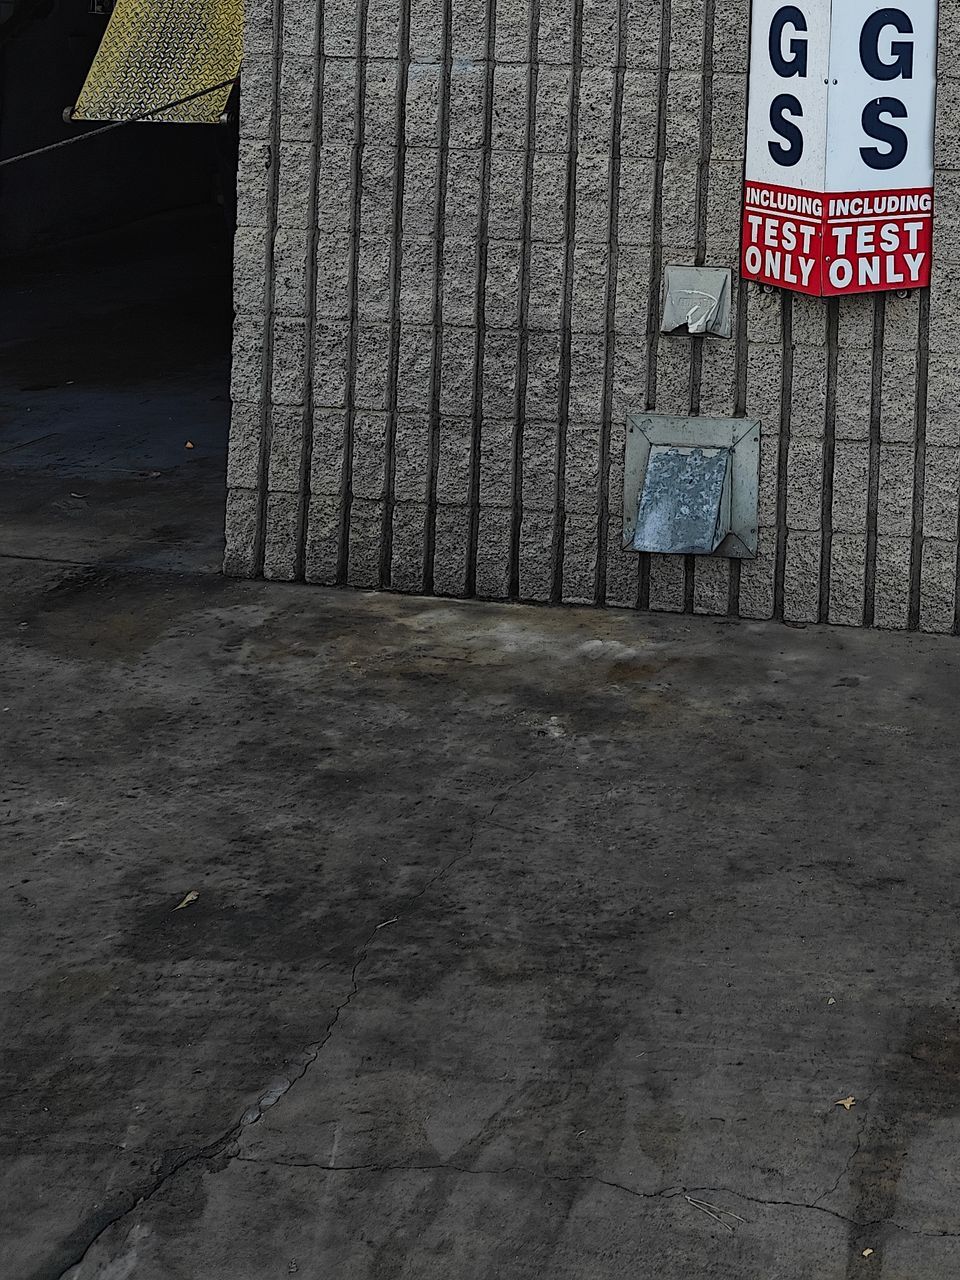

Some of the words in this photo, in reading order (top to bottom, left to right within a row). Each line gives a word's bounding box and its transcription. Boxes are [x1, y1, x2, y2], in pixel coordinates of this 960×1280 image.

[745, 187, 823, 217] INCLUDING
[828, 193, 932, 217] INCLUDING
[748, 214, 816, 254] TEST
[832, 221, 924, 256] TEST
[745, 245, 816, 287] ONLY
[828, 252, 926, 289] ONLY
